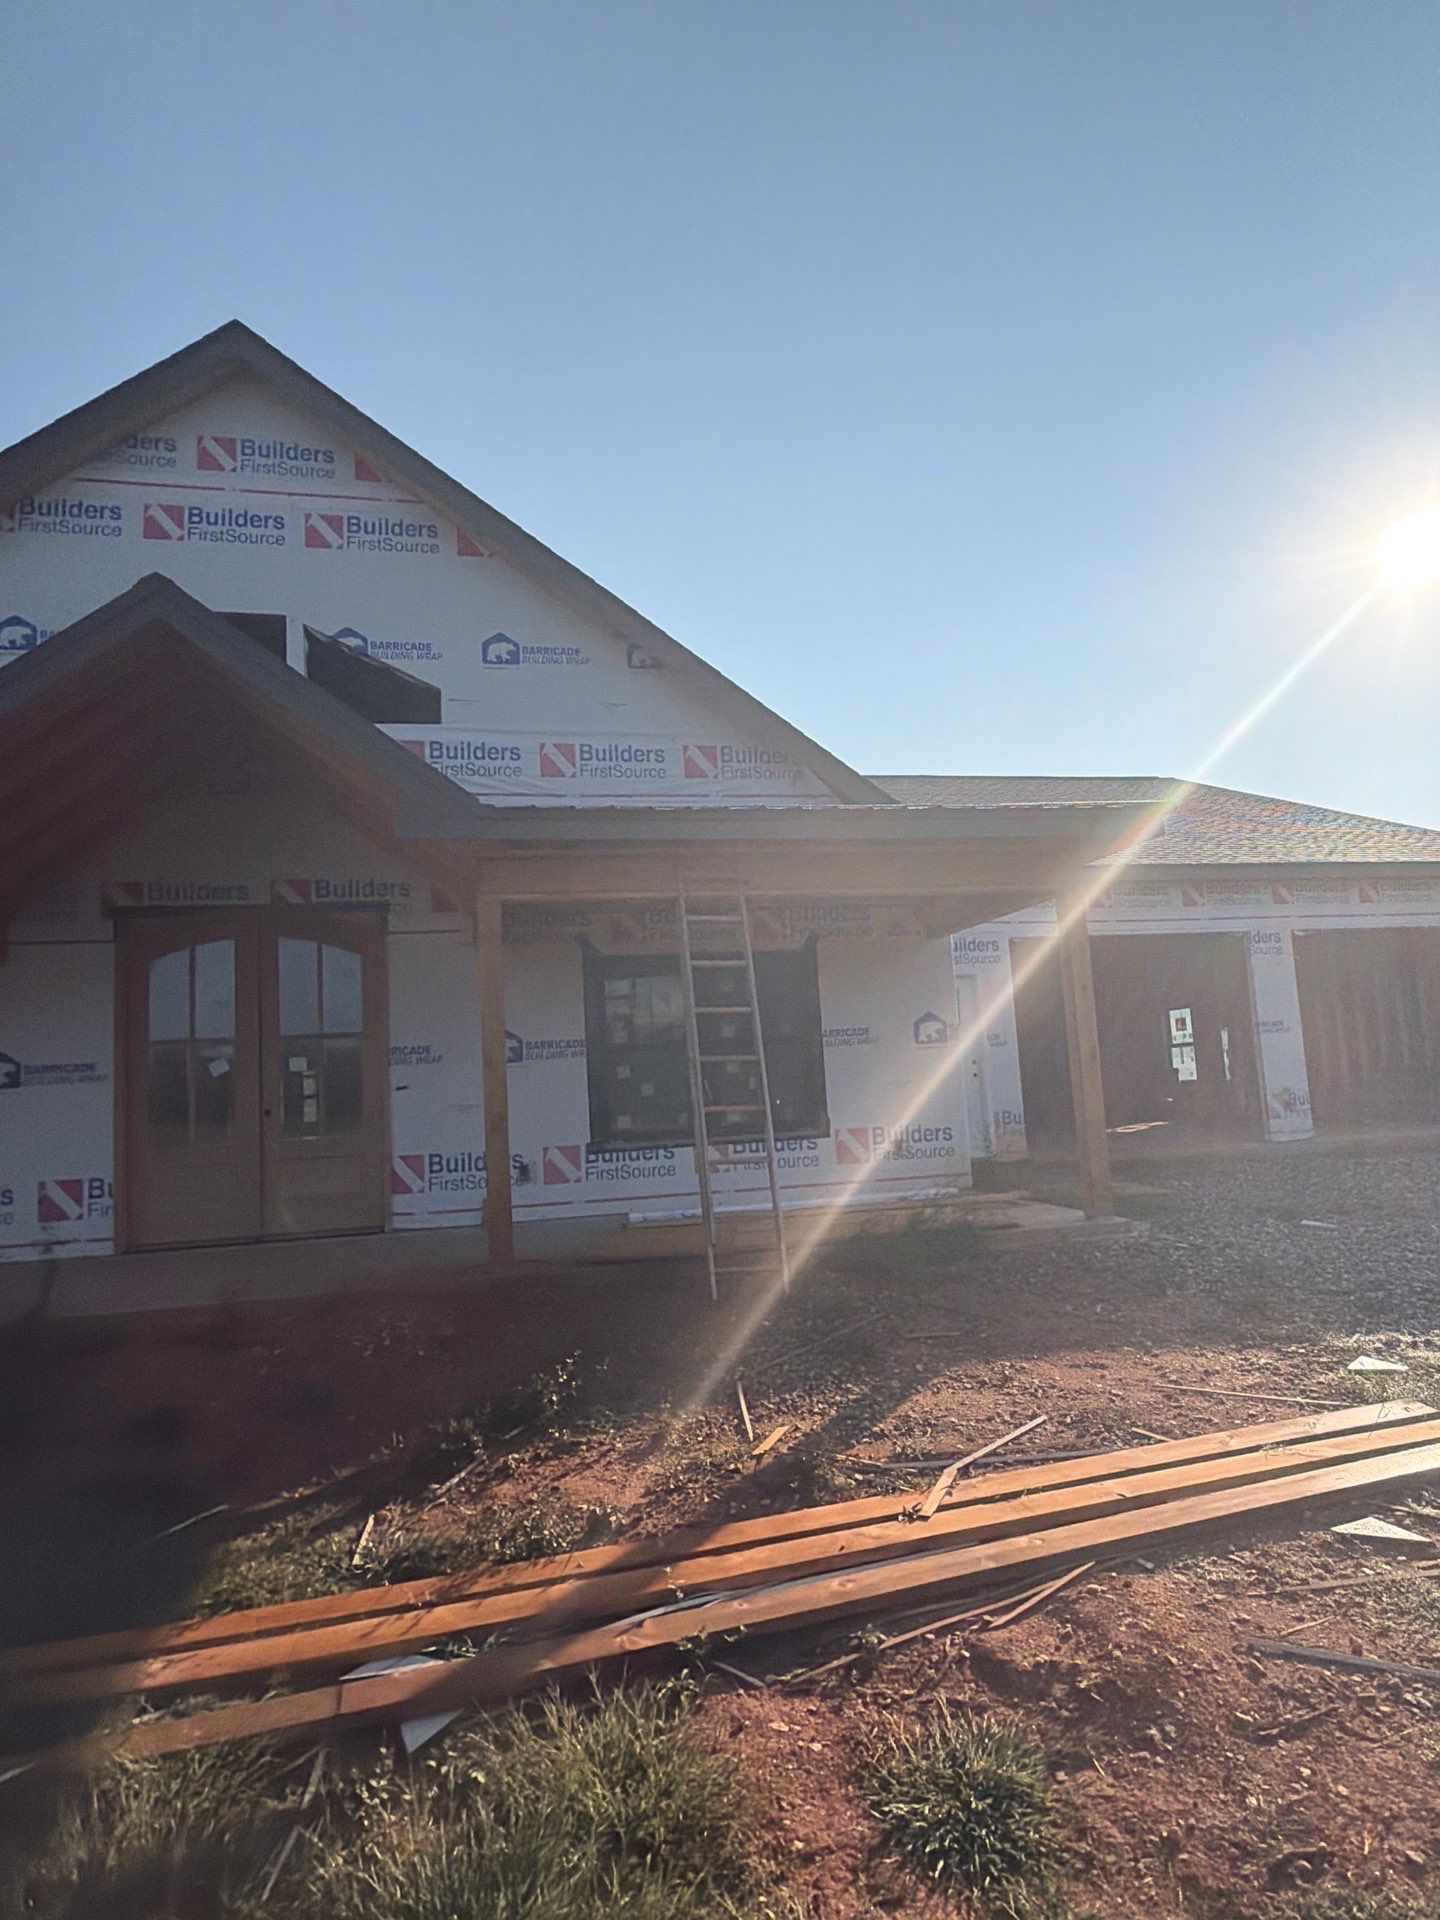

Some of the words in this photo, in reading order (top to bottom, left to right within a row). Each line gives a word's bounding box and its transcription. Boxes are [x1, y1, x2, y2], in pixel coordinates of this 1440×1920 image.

[126, 433, 177, 452] ders
[240, 438, 335, 463] Builders
[240, 459, 336, 479] FirstSource
[20, 497, 122, 521] Builders
[187, 506, 285, 530] Builders
[18, 517, 123, 538] FirstSource
[187, 526, 285, 546] FirstSource
[346, 516, 438, 539] Builders
[346, 537, 440, 555] FirstSource
[370, 641, 432, 652] BARRICADE
[416, 652, 443, 661] WRAP
[522, 646, 581, 657] BARRICADE
[429, 741, 521, 761] Builders
[580, 744, 665, 764] Builders
[580, 764, 666, 780] FirstSource
[315, 878, 411, 899] Builders
[953, 937, 1000, 953] ilders
[1251, 930, 1282, 944] ders
[953, 953, 1001, 966] stSource
[822, 1027, 870, 1038] ARRICADE
[391, 1045, 432, 1056] RICADE
[873, 1124, 953, 1146] Builders
[428, 1151, 524, 1174] Builds
[585, 1164, 676, 1181] FirstSource
[428, 1173, 525, 1193] FirstSoce
